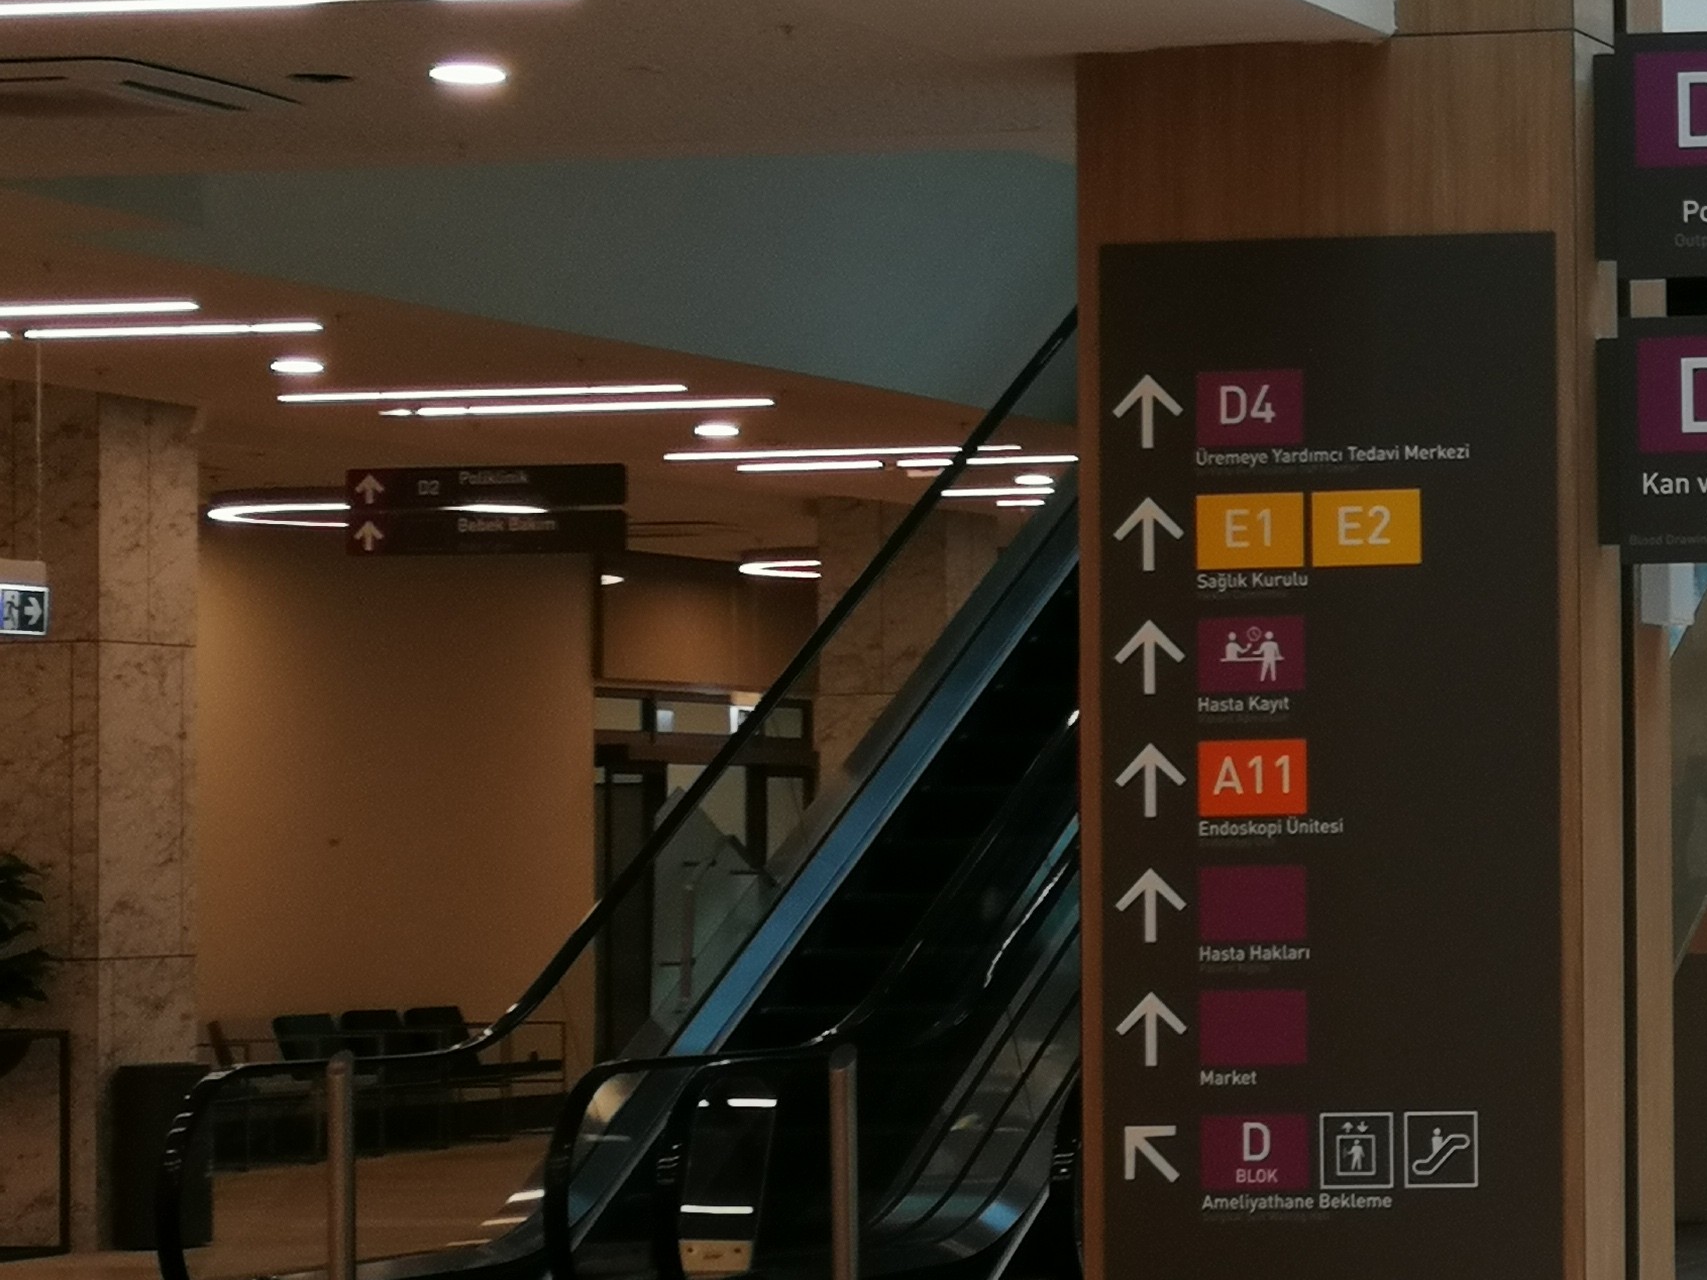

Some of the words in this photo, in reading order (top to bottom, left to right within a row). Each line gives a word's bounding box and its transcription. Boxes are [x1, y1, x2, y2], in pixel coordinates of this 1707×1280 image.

[1219, 384, 1276, 425] D4
[1195, 447, 1269, 468] Üremeye
[1271, 448, 1343, 464] Yardımcı
[1347, 445, 1400, 462] Tedavi
[1404, 443, 1470, 460] Merkezi
[1642, 472, 1690, 495] Kan
[1224, 508, 1272, 549] E1
[1337, 505, 1391, 546] E2
[1196, 572, 1248, 593] Sağlık
[1251, 571, 1309, 588] Kurulu
[1197, 696, 1244, 713] Hasta
[1248, 695, 1290, 715] Kayıt
[1213, 754, 1290, 795] A11
[1198, 818, 1282, 839] Endoskopi
[1286, 815, 1344, 835] Ünitesi
[1199, 945, 1246, 962] Hasta
[1249, 944, 1311, 961] Hakları
[1199, 1069, 1257, 1086] Market
[1242, 1121, 1271, 1162] D
[1235, 1168, 1278, 1184] BLOK
[1201, 1193, 1315, 1214] Ameliyathane
[1318, 1192, 1393, 1209] Bekleme
